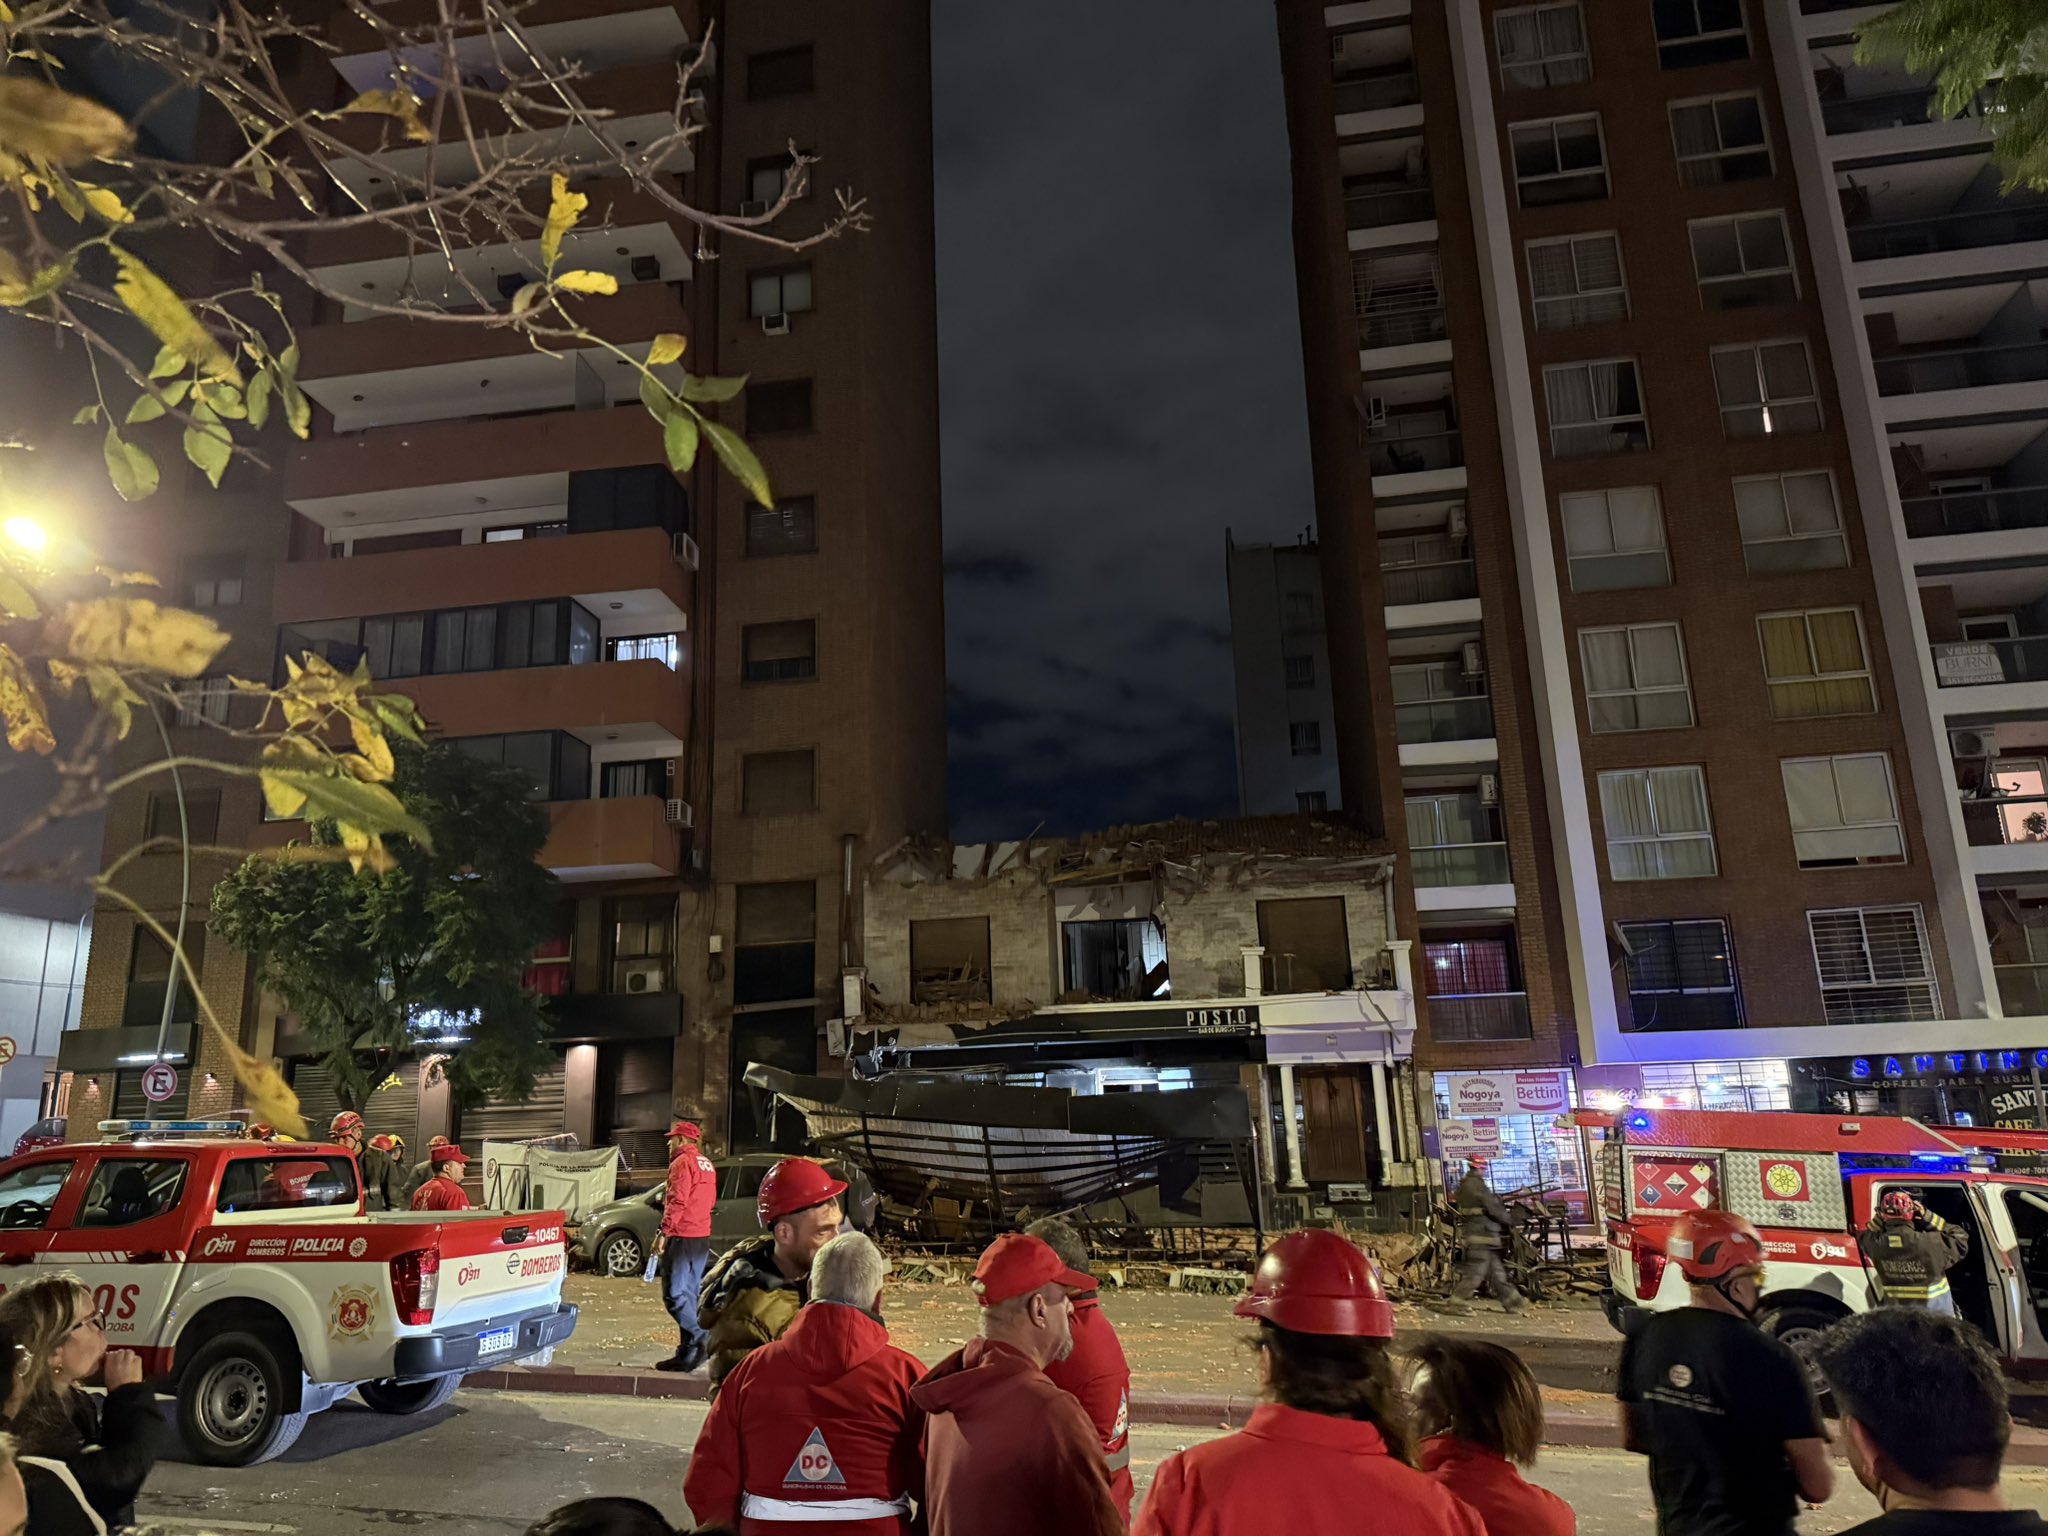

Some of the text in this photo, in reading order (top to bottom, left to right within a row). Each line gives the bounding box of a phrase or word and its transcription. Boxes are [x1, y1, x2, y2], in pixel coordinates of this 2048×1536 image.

[1946, 645, 1988, 655] VENDE
[1186, 1008, 1247, 1026] POSTO
[1853, 1050, 2048, 1077] SANTINO
[152, 1071, 171, 1093] E
[1872, 1079, 1928, 1088] COFFEE
[1939, 1077, 1967, 1086] BAR
[1993, 1075, 2031, 1085] SUSH
[1459, 1089, 1501, 1102] Nogoya
[1516, 1086, 1563, 1099] Bettini
[1442, 1133, 1469, 1141] Nogoya
[1472, 1128, 1497, 1137] Bettini
[246, 1247, 286, 1256] BOMBEROS
[292, 1238, 344, 1252] POLICIA
[521, 1254, 562, 1277] BOMBEROS
[802, 1454, 828, 1470] DC
